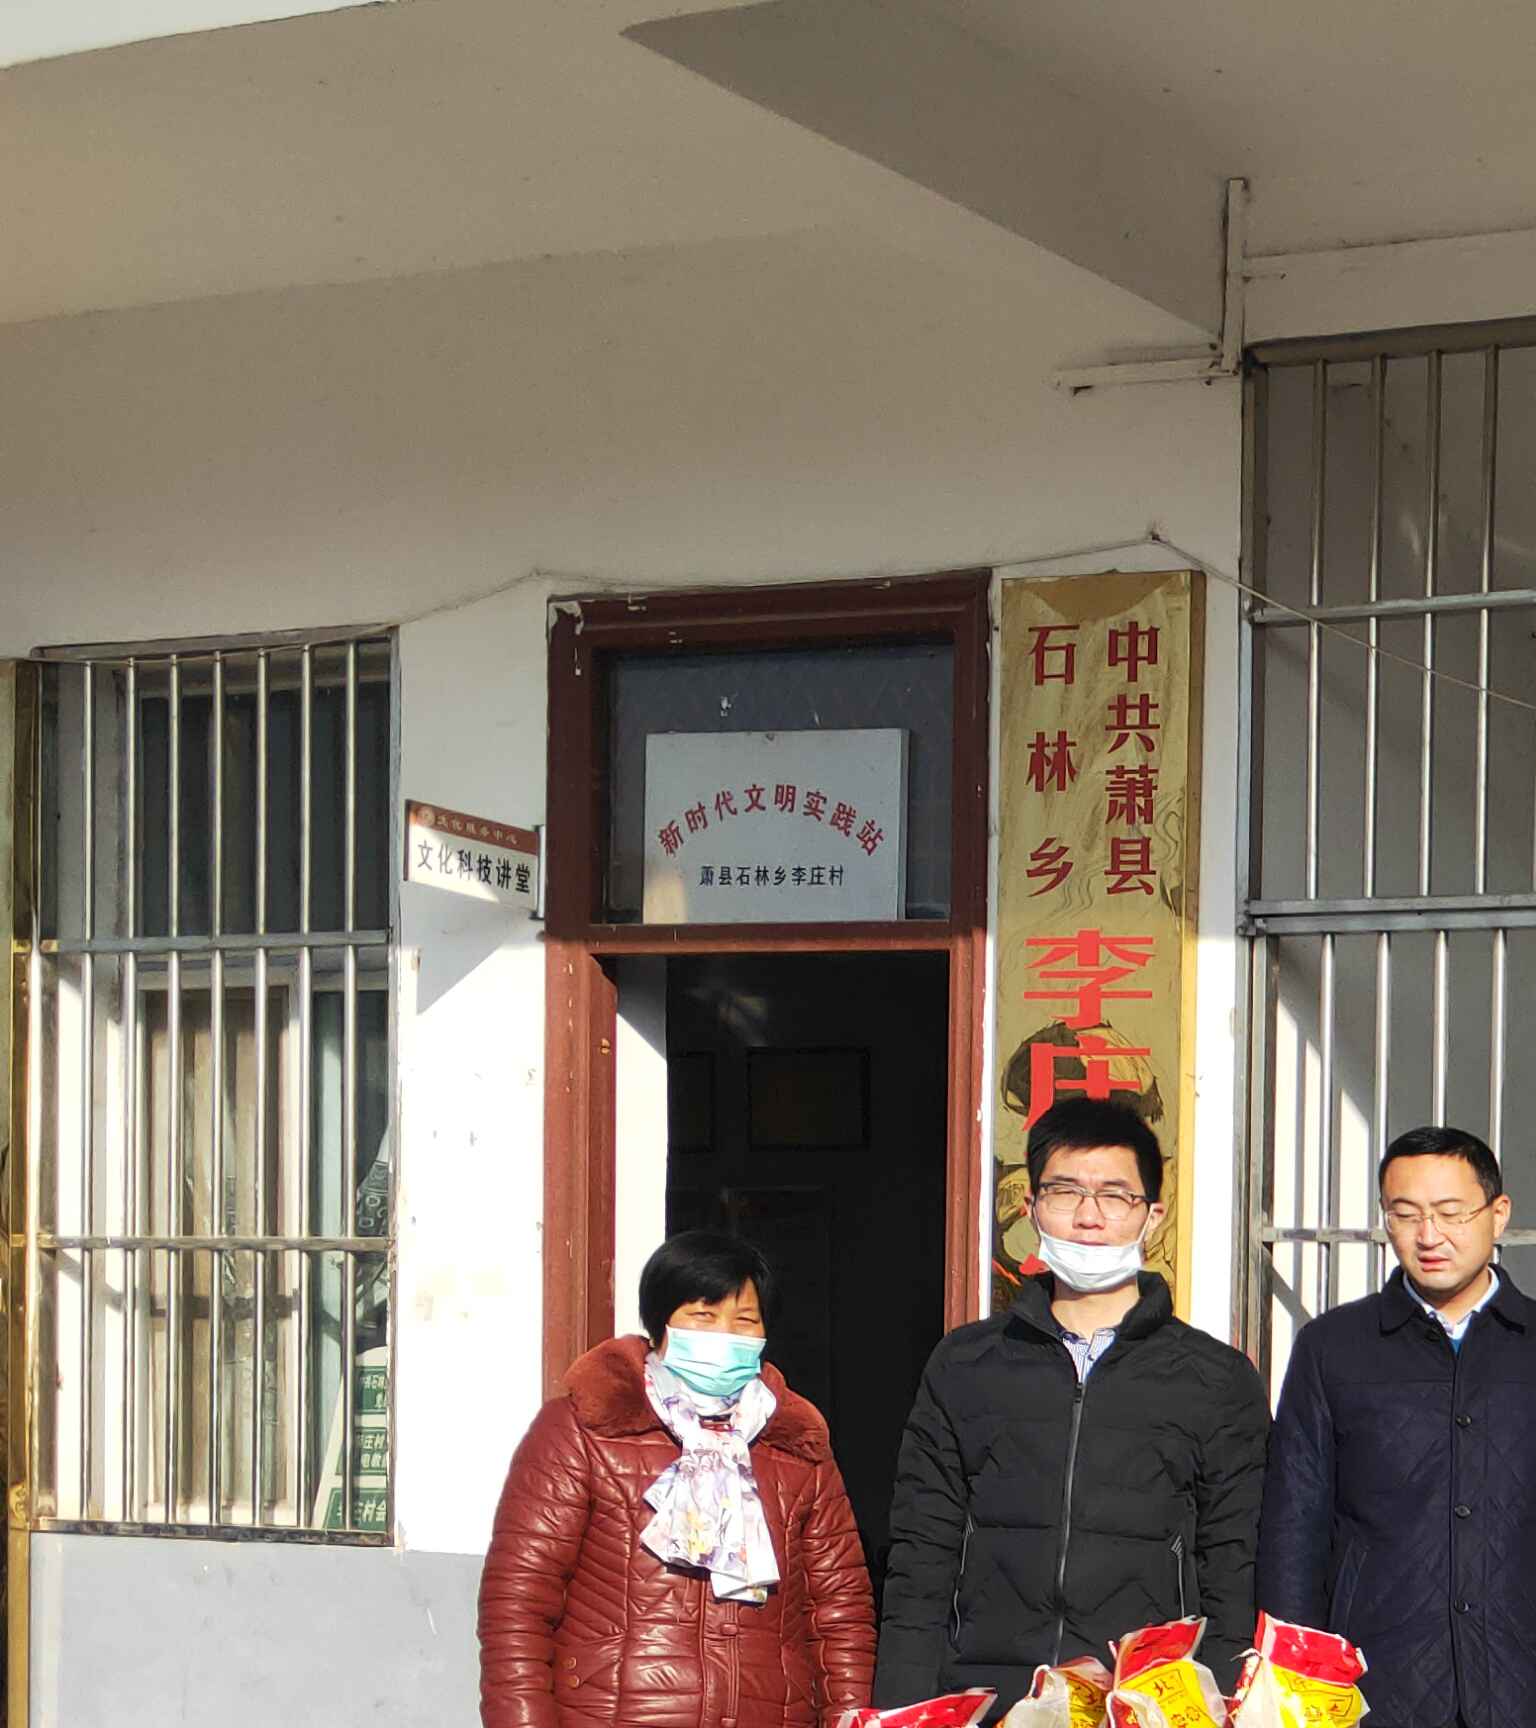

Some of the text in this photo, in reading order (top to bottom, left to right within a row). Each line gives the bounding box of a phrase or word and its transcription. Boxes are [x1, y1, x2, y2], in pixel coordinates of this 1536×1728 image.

[1025, 623, 1078, 896] 石林乡
[1104, 620, 1161, 897] 中共萧县
[657, 783, 886, 857] 新时代文明实践站
[417, 839, 531, 894] 文化科技讲堂
[698, 864, 848, 887] 萧县石林乡李庄村
